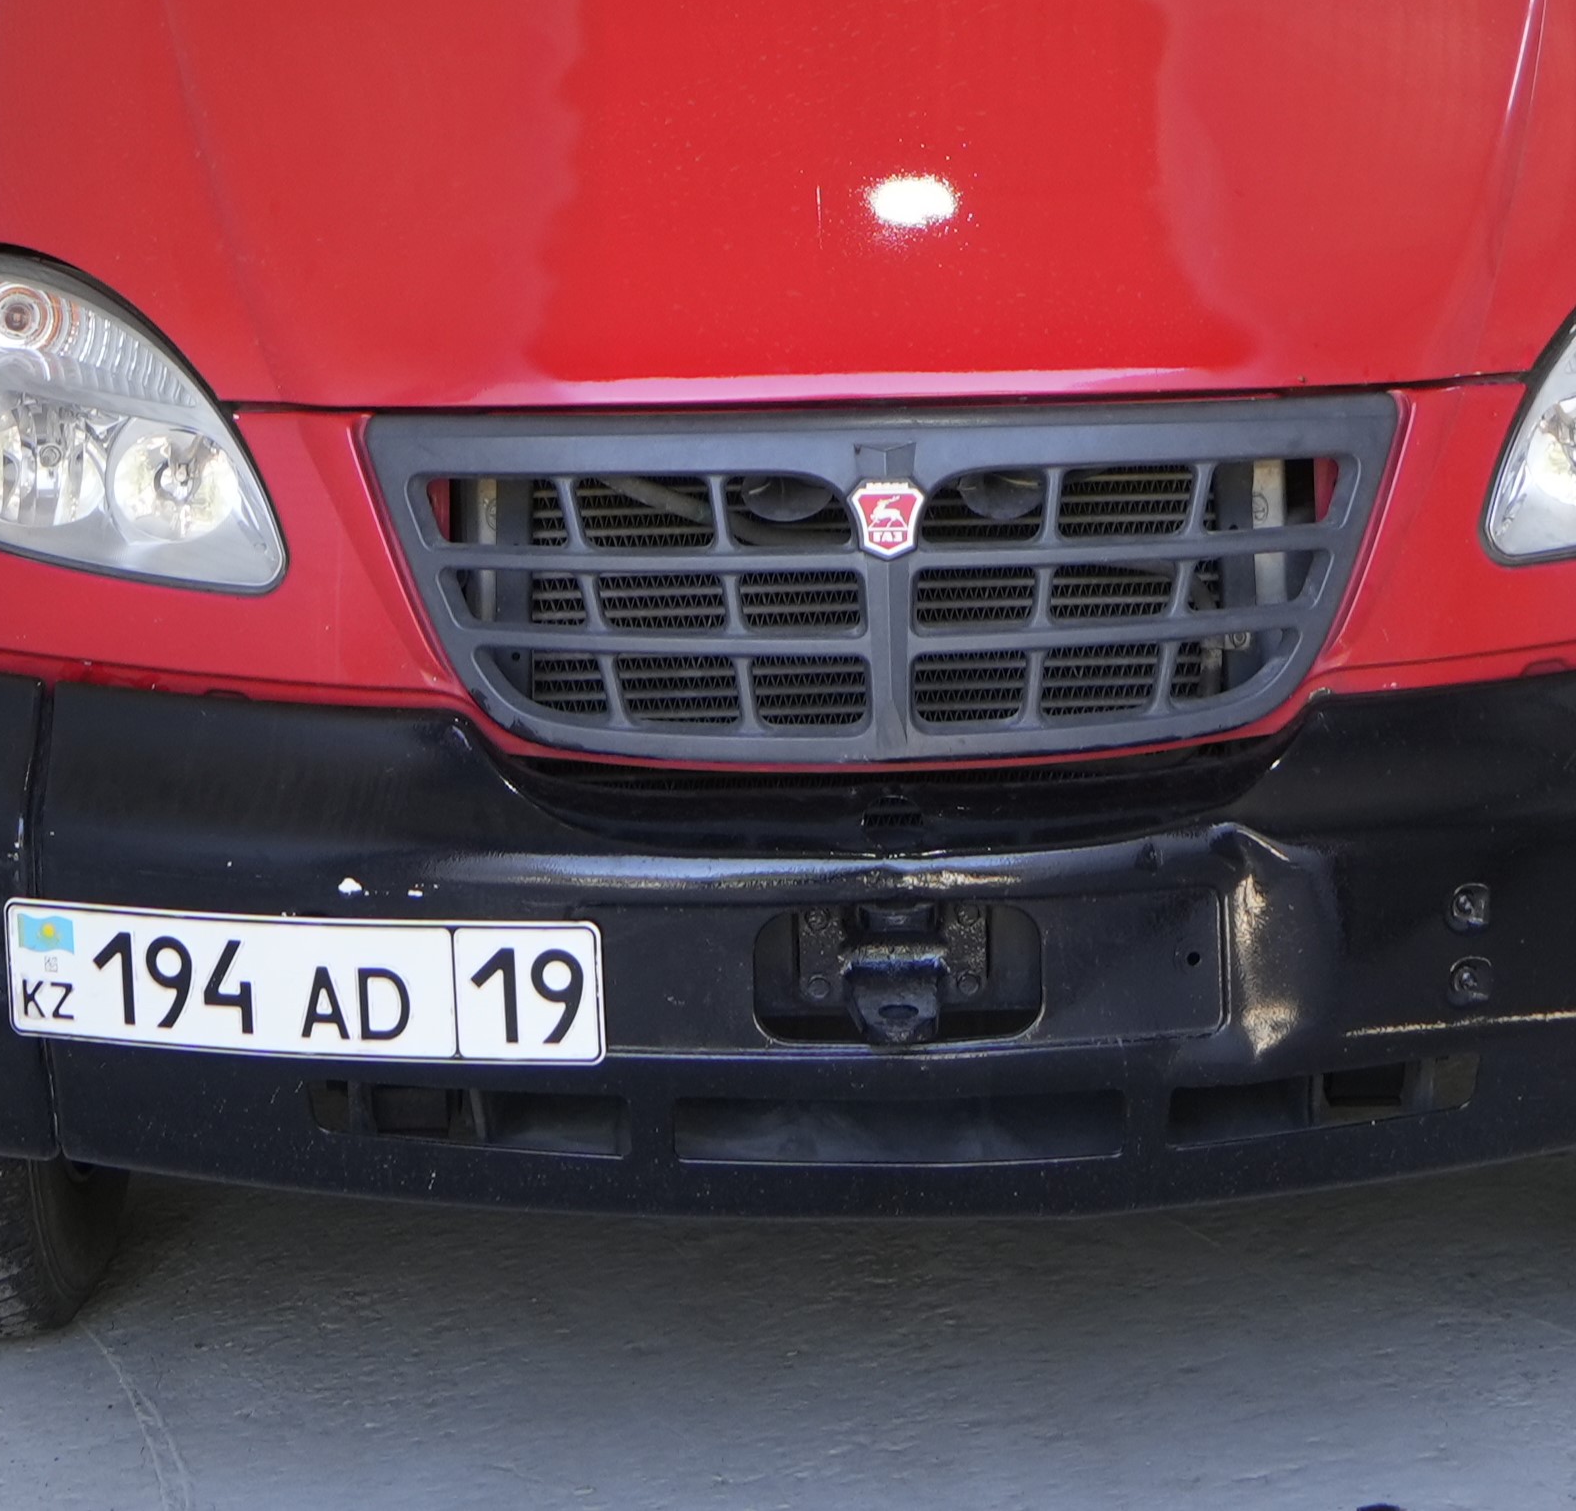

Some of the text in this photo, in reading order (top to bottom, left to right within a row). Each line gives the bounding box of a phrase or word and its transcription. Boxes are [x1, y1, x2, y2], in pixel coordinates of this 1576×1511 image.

[872, 531, 903, 543] ГАЗ
[22, 978, 76, 1021] KZ
[92, 931, 585, 1045] 194 AD 19
